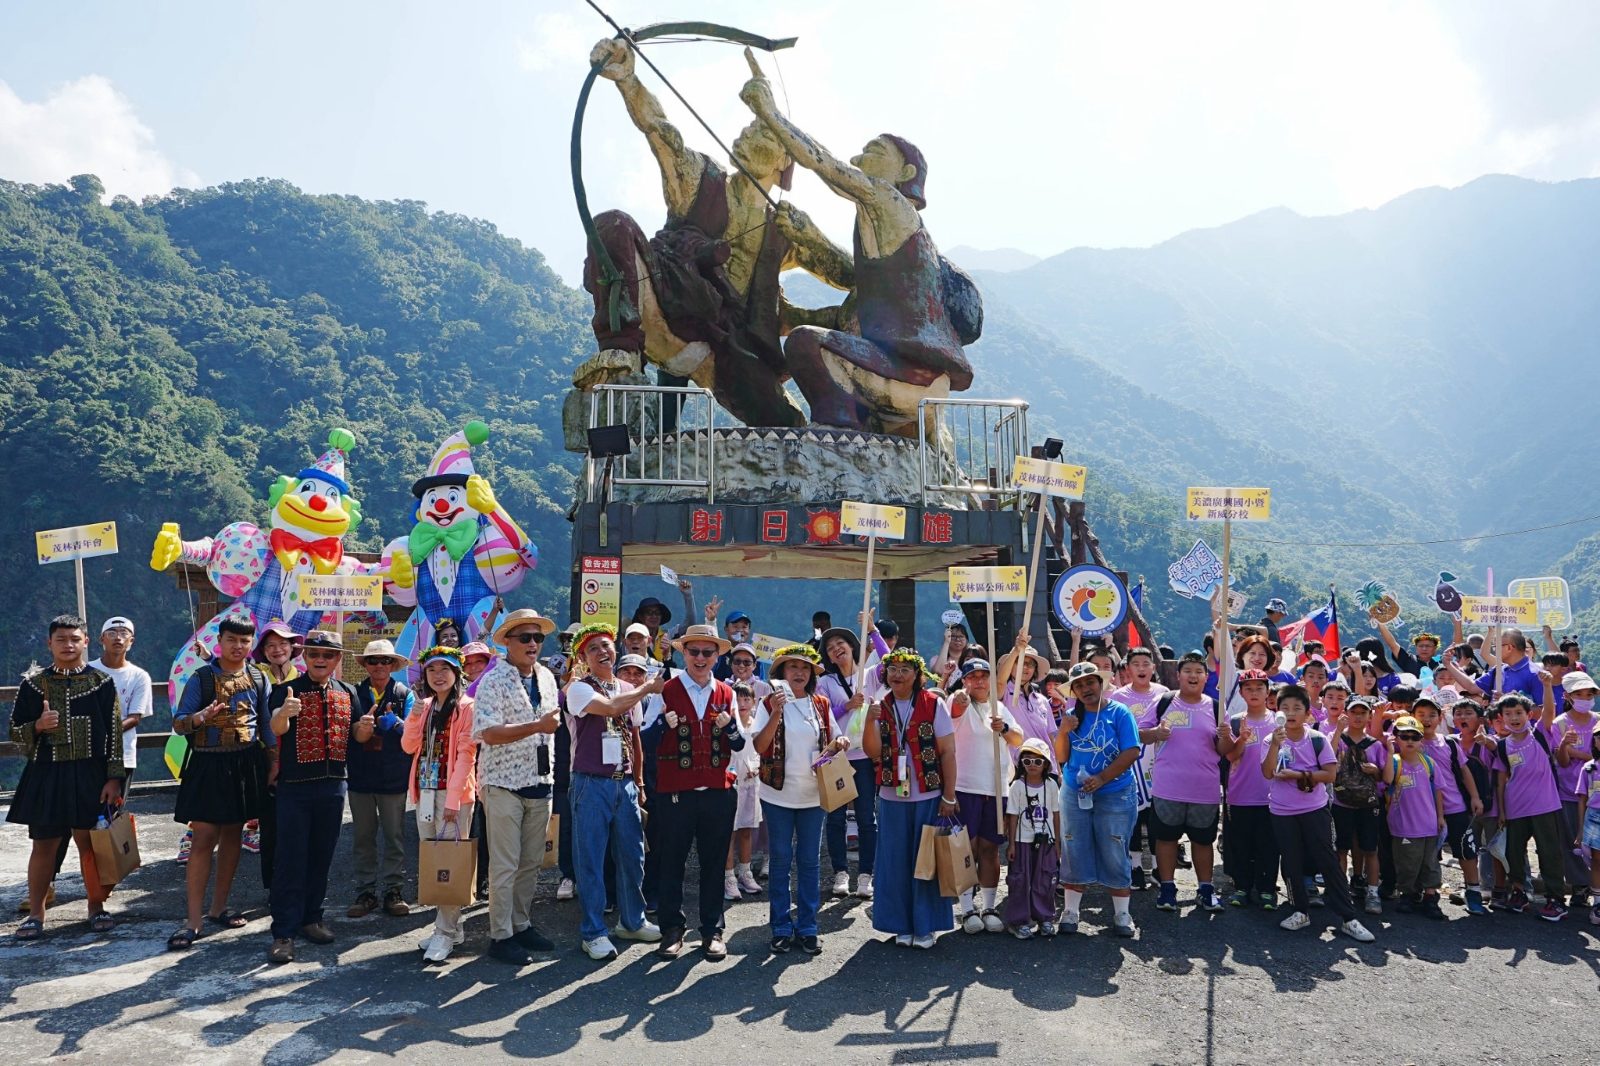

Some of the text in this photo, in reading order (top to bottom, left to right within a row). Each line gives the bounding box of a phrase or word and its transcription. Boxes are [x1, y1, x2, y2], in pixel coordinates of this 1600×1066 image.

[857, 516, 890, 529] 茂林國小
[53, 538, 102, 553] 茂林青年會
[584, 559, 619, 569] 敬告遊客
[309, 587, 373, 597] 茂林國家風景區
[956, 582, 1020, 593] 茂林區公所A隊
[313, 598, 368, 607] 管理處志工隊
